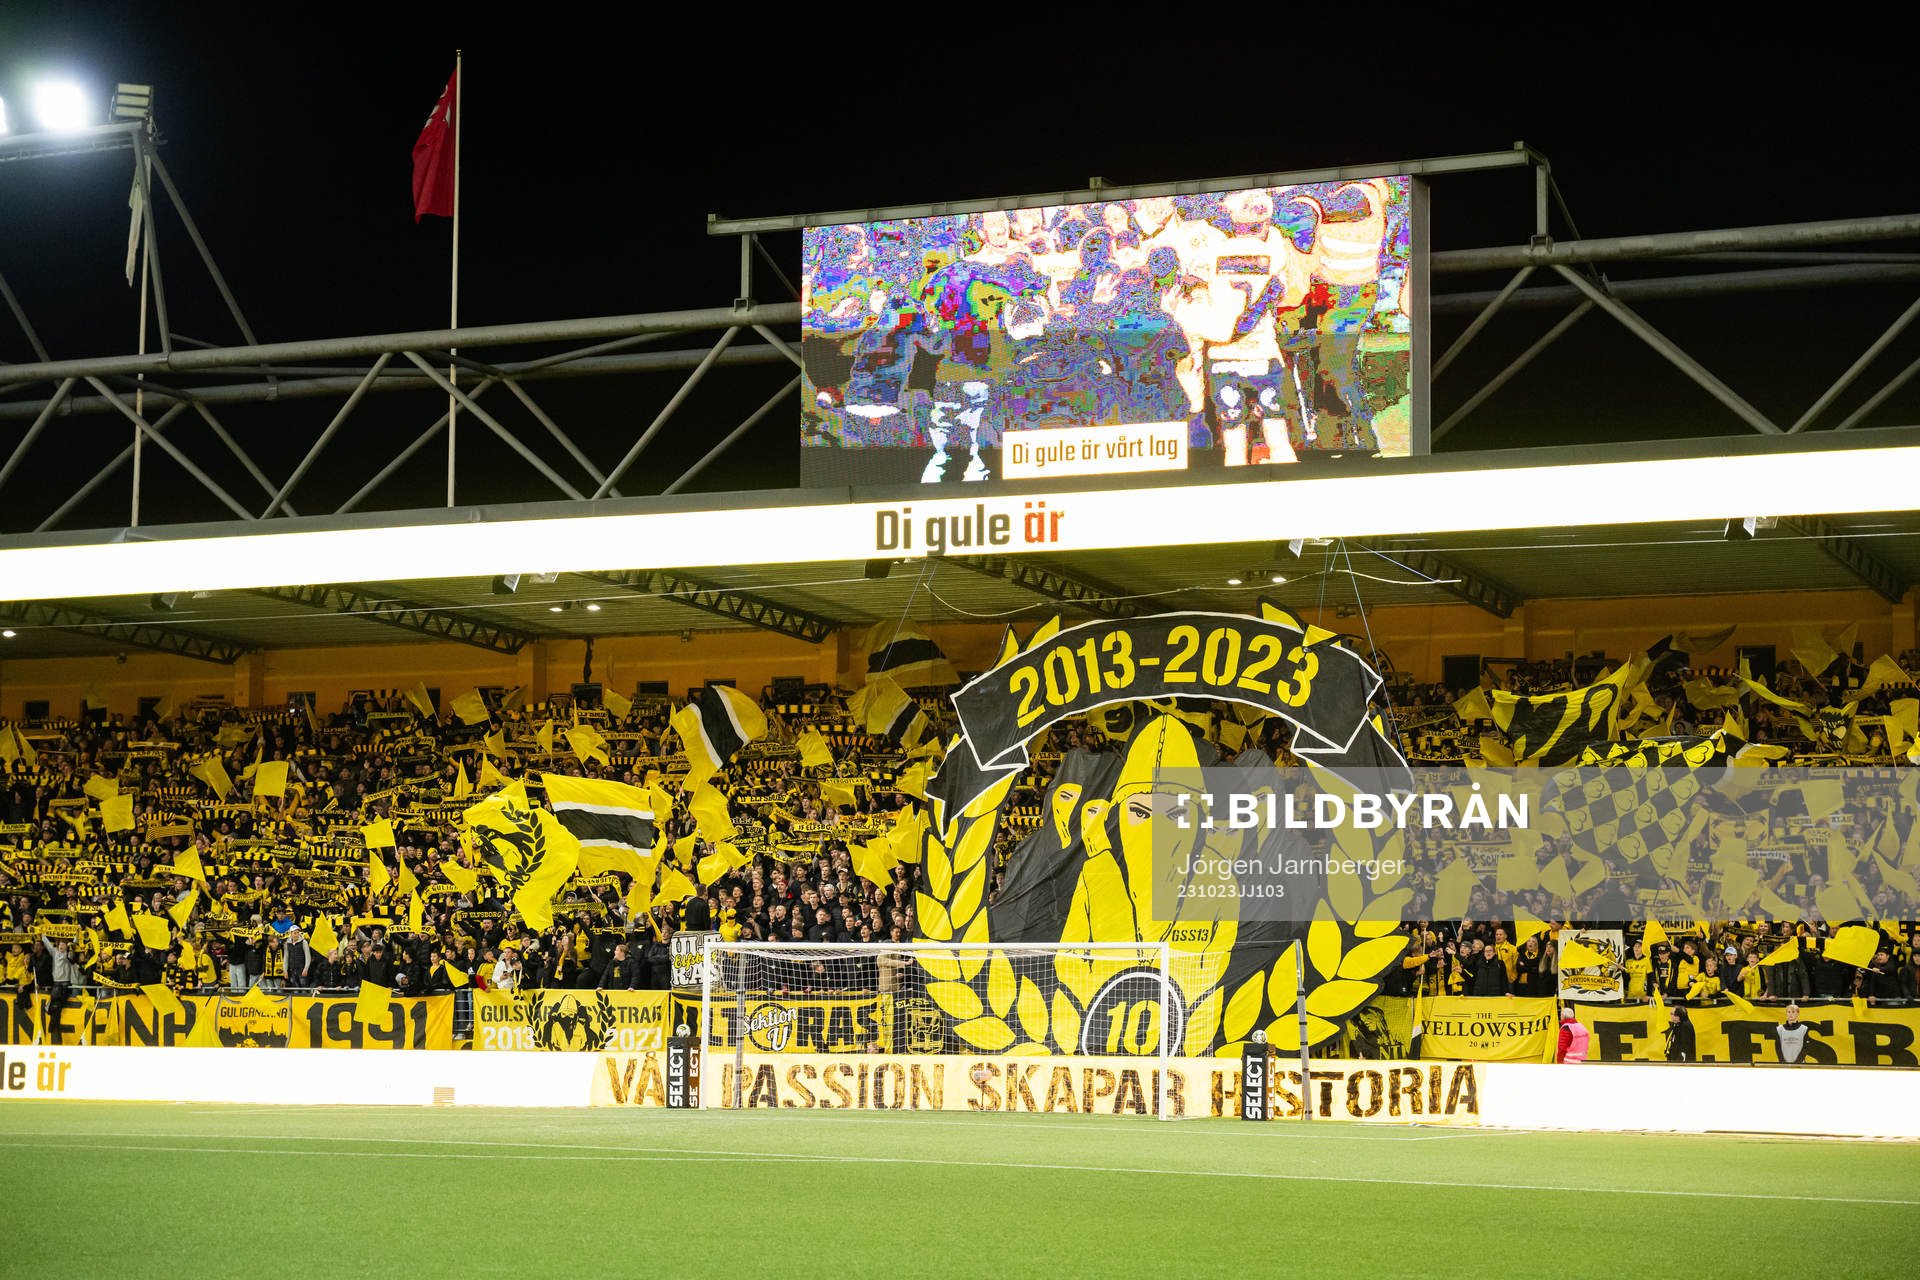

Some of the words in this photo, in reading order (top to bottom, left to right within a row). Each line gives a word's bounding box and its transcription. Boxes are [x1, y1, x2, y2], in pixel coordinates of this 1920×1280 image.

[1012, 442, 1029, 465] Di
[1036, 440, 1075, 467] gule
[1081, 439, 1100, 461] är
[1106, 435, 1143, 459] vårt
[1149, 434, 1178, 461] lag
[876, 507, 913, 550] Di
[925, 504, 1010, 557] gule
[1024, 501, 1065, 544] är
[1009, 625, 1320, 729] 2013-2023
[1171, 929, 1210, 943] GSS13
[306, 1001, 427, 1050] 1991
[742, 1008, 797, 1035] Sektion
[1106, 1000, 1161, 1056] 10
[1421, 1014, 1551, 1038] YELLOWSHIP
[1475, 1012, 1493, 1020] THE
[482, 1027, 536, 1051] 2013
[606, 1027, 662, 1051] 2023
[767, 1026, 789, 1052] U
[37, 1052, 72, 1091] är
[669, 1046, 684, 1108] SELECT
[721, 1063, 945, 1109] PASSION
[967, 1062, 1186, 1117] SKAPAR
[1211, 1063, 1479, 1119] HSTORIA
[1245, 1055, 1263, 1119] SELECT
